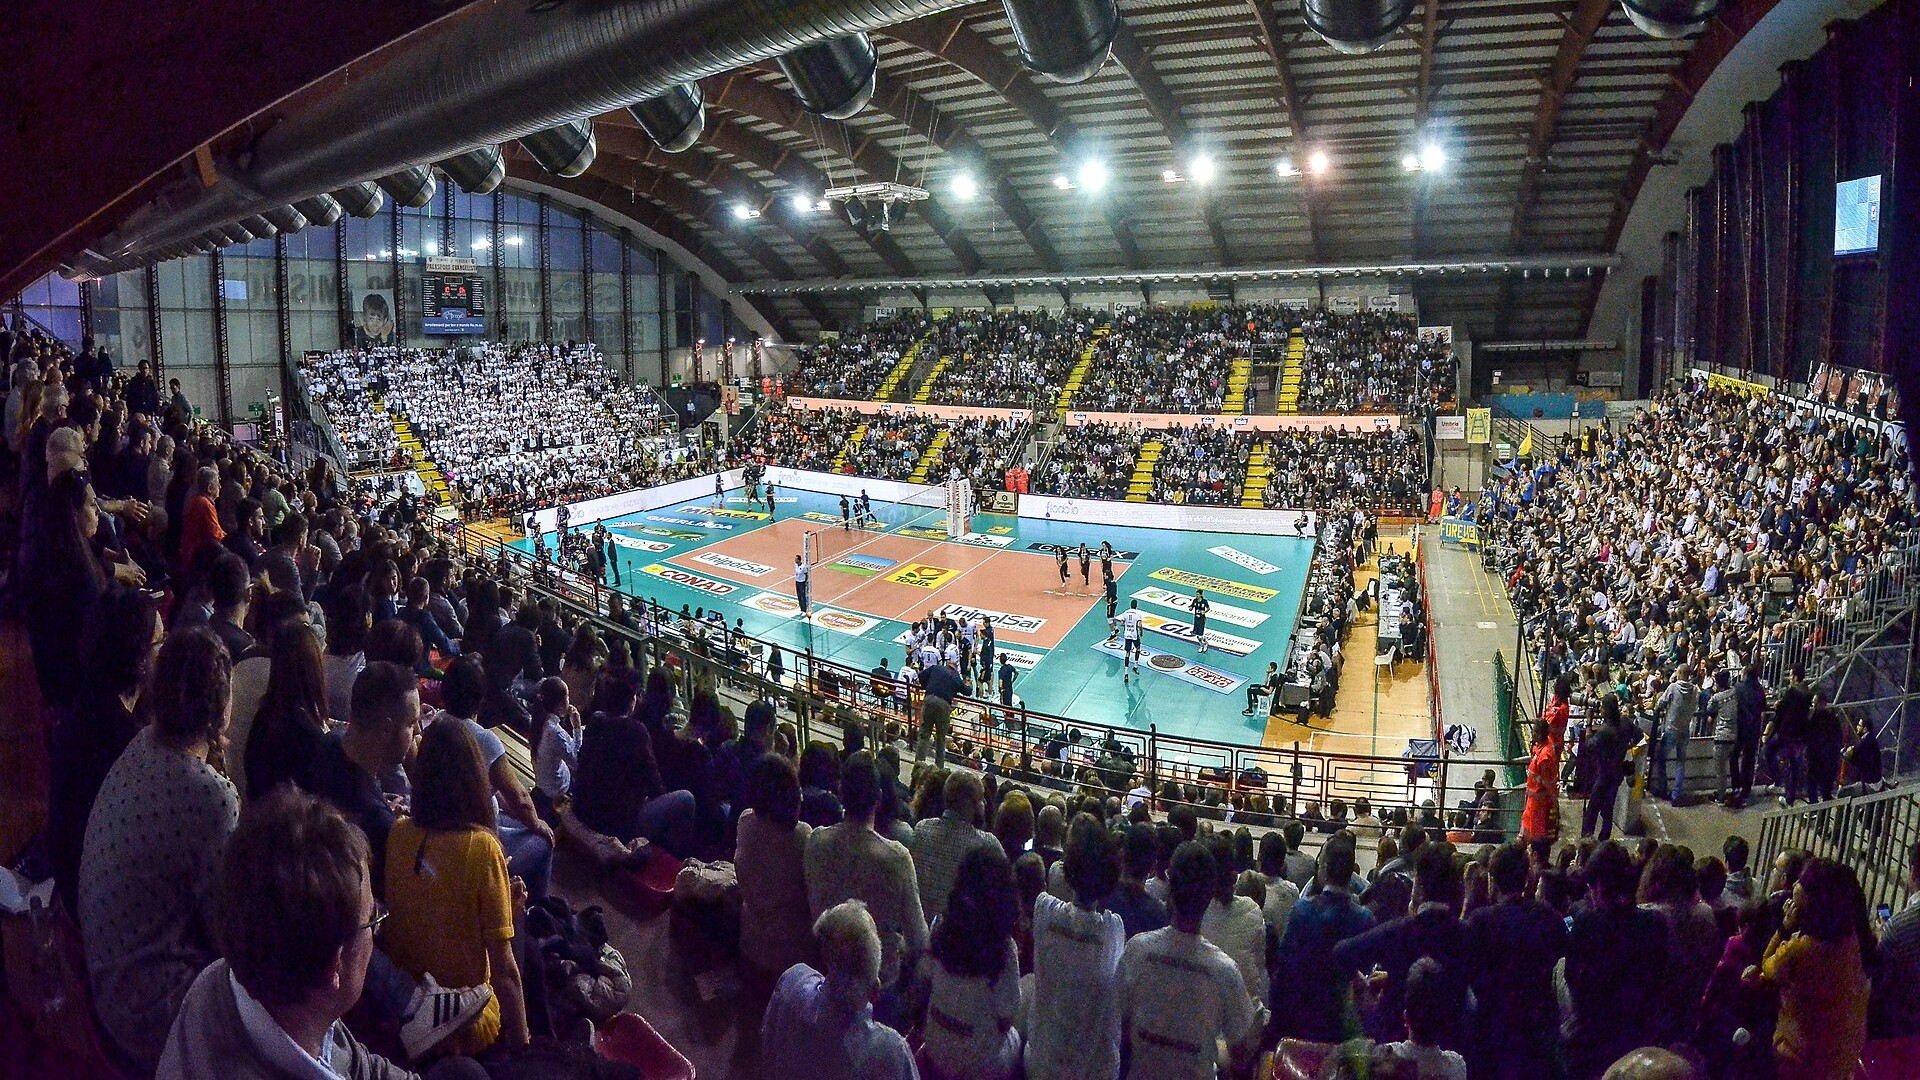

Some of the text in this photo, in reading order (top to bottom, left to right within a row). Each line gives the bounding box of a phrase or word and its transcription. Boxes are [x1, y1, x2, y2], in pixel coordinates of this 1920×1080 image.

[646, 515, 734, 530] GHERLINDA
[679, 506, 761, 521] MIKASA
[1439, 521, 1478, 540] FOREVE
[700, 552, 774, 576] UnipolSai
[659, 569, 734, 595] CONAD
[893, 576, 932, 588] Todis
[942, 604, 1043, 630] UnipolSai
[1187, 668, 1229, 687] GELATO
